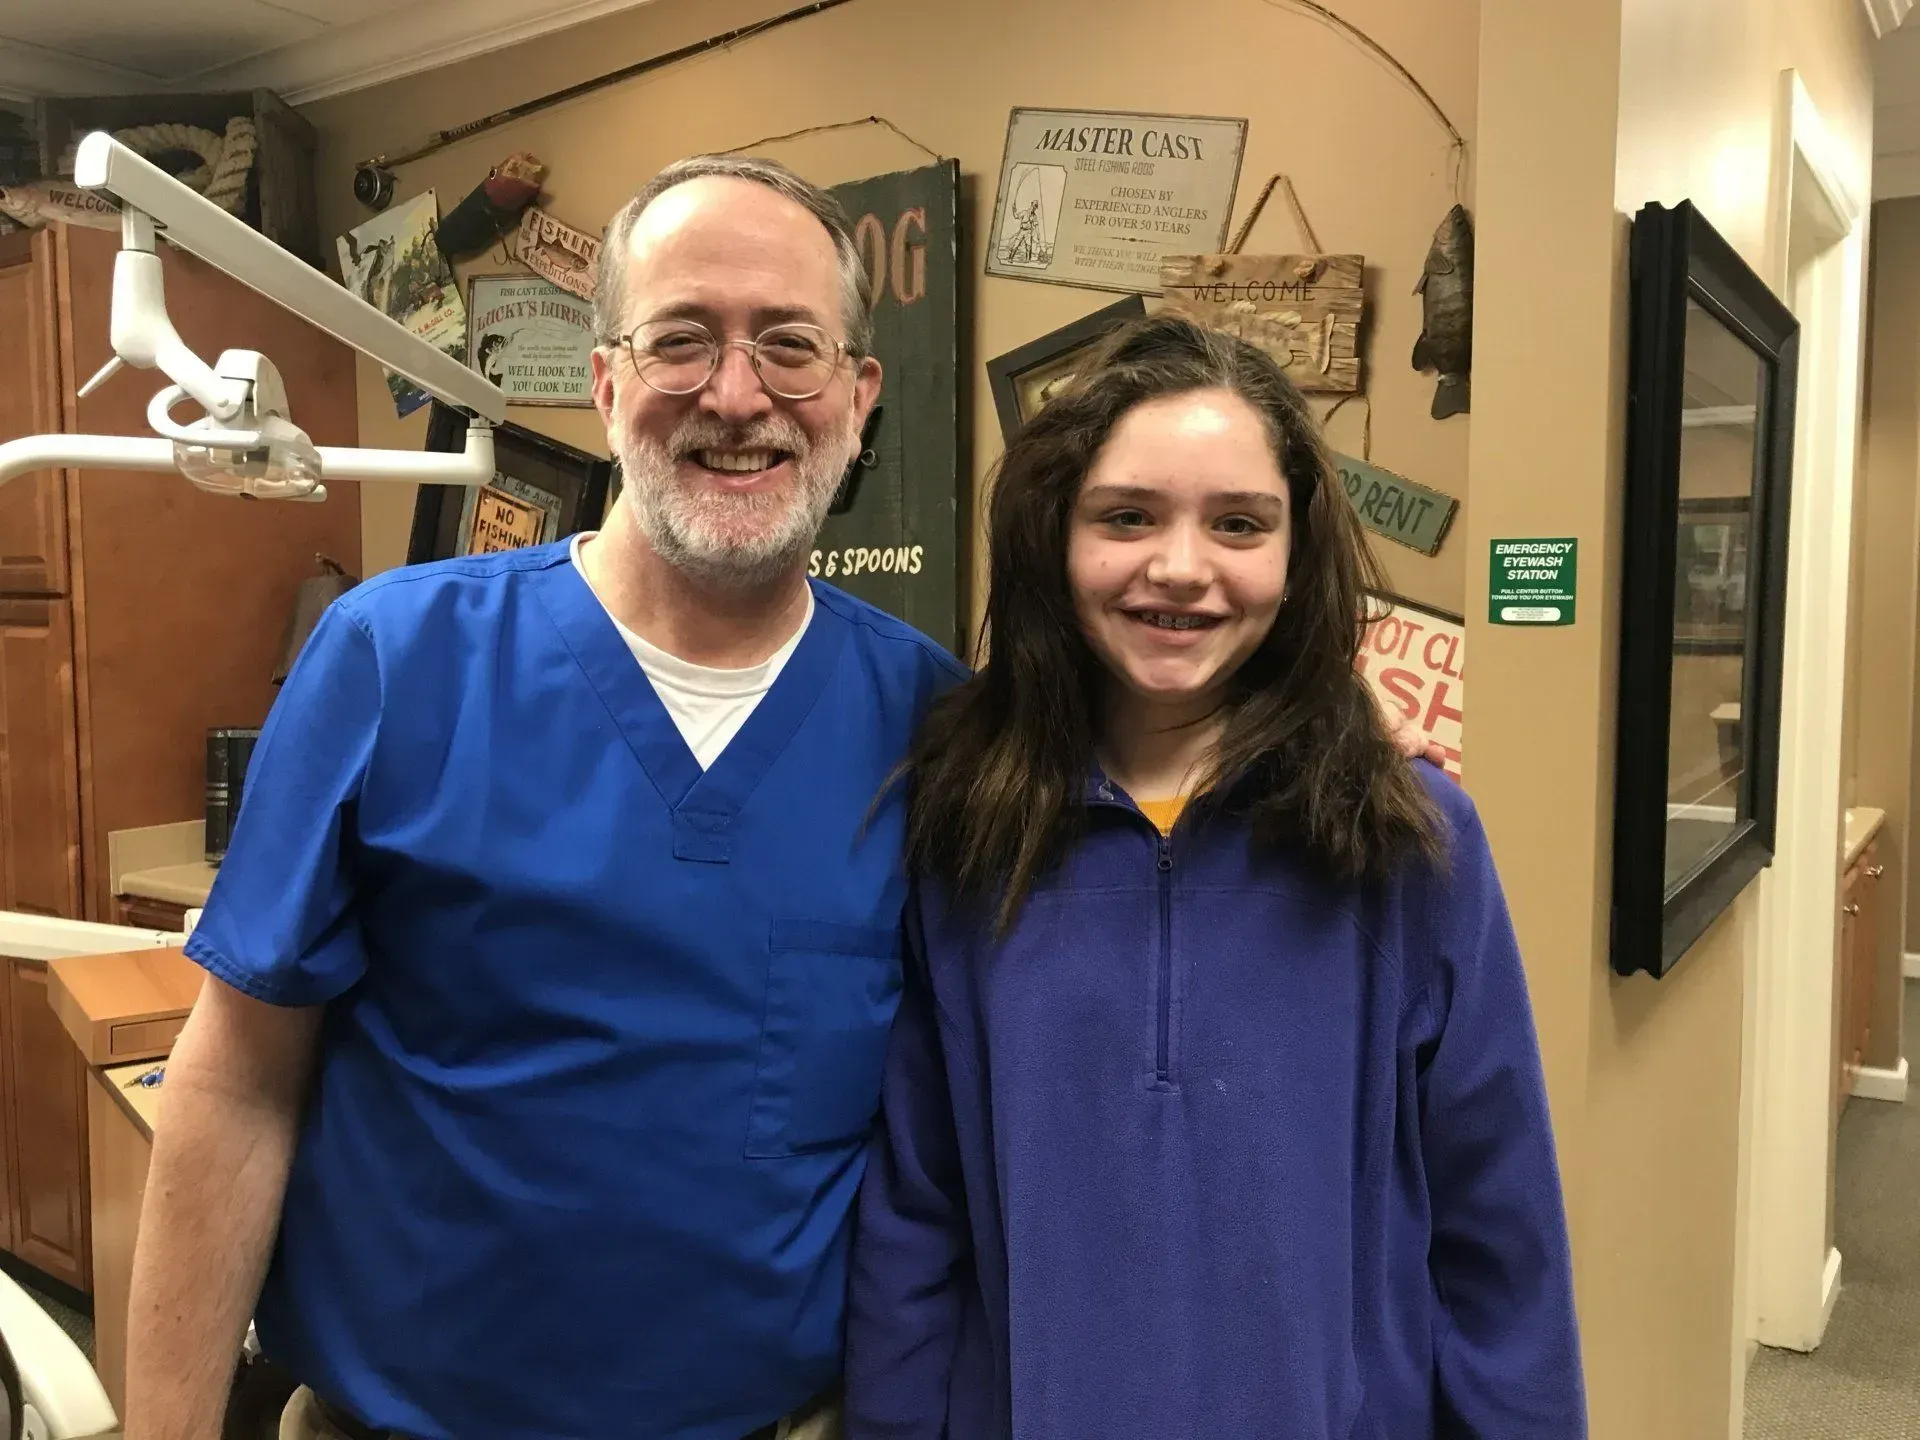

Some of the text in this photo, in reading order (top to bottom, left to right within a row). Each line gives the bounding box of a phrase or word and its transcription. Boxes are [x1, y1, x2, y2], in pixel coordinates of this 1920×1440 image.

[1034, 127, 1204, 161] MASTER CAST
[1074, 157, 1156, 176] STEEL FISHING RODS
[49, 190, 122, 214] WELCOM
[1111, 186, 1175, 202] CHOSEN BY
[1074, 199, 1208, 221] EXPERIENCED ANGLERS
[1084, 214, 1191, 235] FOR OVER 50 YEARS
[1074, 256, 1096, 268] WITH
[1087, 246, 1115, 259] THINK
[529, 251, 588, 294] EXPEDITIONS
[500, 286, 561, 297] FISH CAN'T RESIS
[1193, 280, 1315, 303] WELCOME
[477, 300, 591, 332] LUCKY'S LURES
[508, 364, 535, 377] WE'LL
[537, 365, 565, 378] HOOK
[512, 380, 532, 393] YOU
[533, 381, 560, 393] COOK
[495, 505, 515, 526] NO
[1360, 481, 1434, 534] RENT
[1495, 543, 1573, 555] EMERGENCY
[825, 550, 839, 578] &
[841, 545, 924, 576] SPOONS
[1503, 556, 1564, 568] EYEWASH
[1507, 569, 1559, 581] STATION
[1423, 632, 1464, 681] CL
